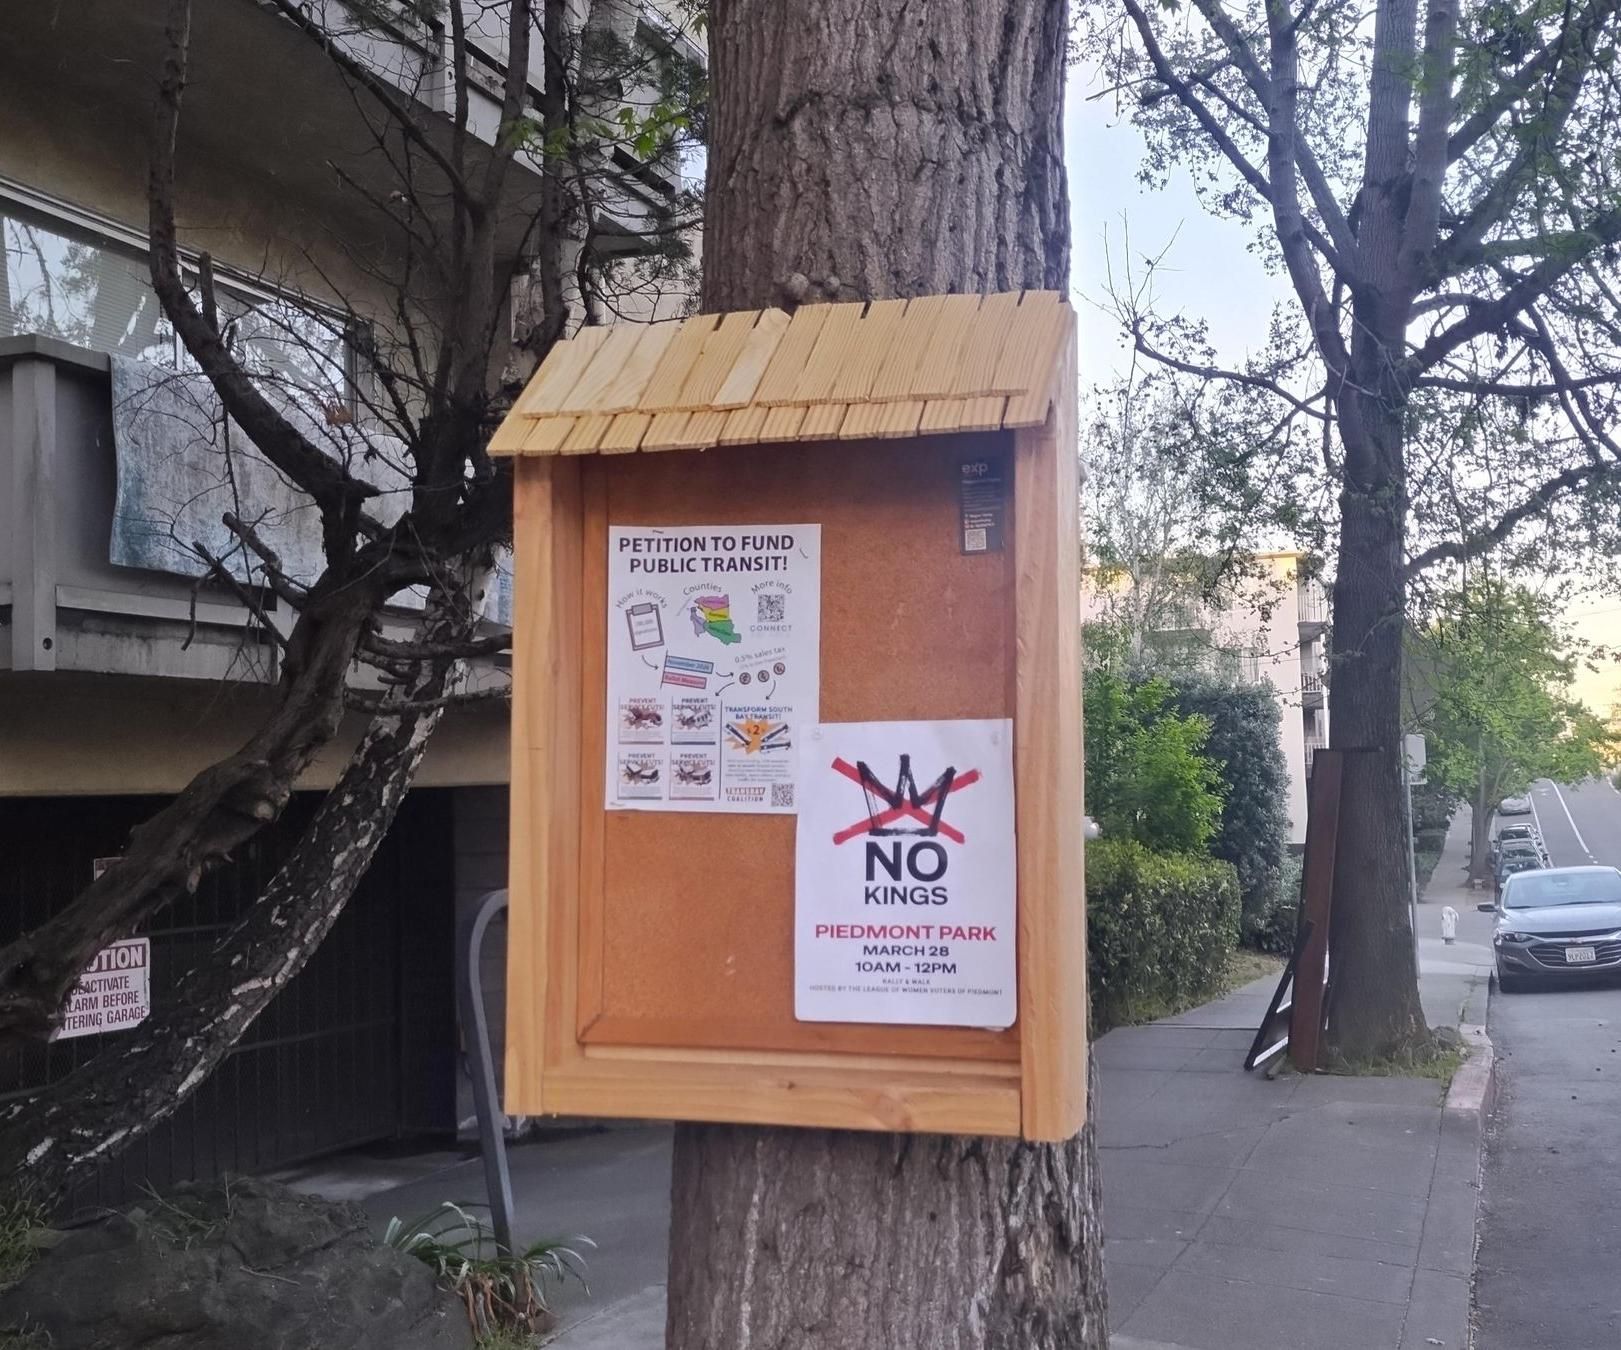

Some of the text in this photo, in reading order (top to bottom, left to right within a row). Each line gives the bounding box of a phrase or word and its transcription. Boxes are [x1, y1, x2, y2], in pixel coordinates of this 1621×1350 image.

[619, 535, 794, 553] PETITION TO FUND
[630, 556, 788, 573] PUBLIC TRANSIT!
[683, 582, 722, 596] Counties
[751, 580, 792, 594] More info
[616, 588, 668, 609] How it works
[865, 841, 948, 882] NO
[864, 886, 948, 905] KINGS
[815, 924, 997, 941] PIEDMONT PARK
[86, 946, 143, 972] UTION
[863, 945, 949, 957] MARCH 28
[855, 962, 900, 973] 10AM
[914, 962, 957, 974] 12PM
[103, 991, 139, 1008] BEFORE
[61, 1006, 146, 1031] TERING GARAGE
